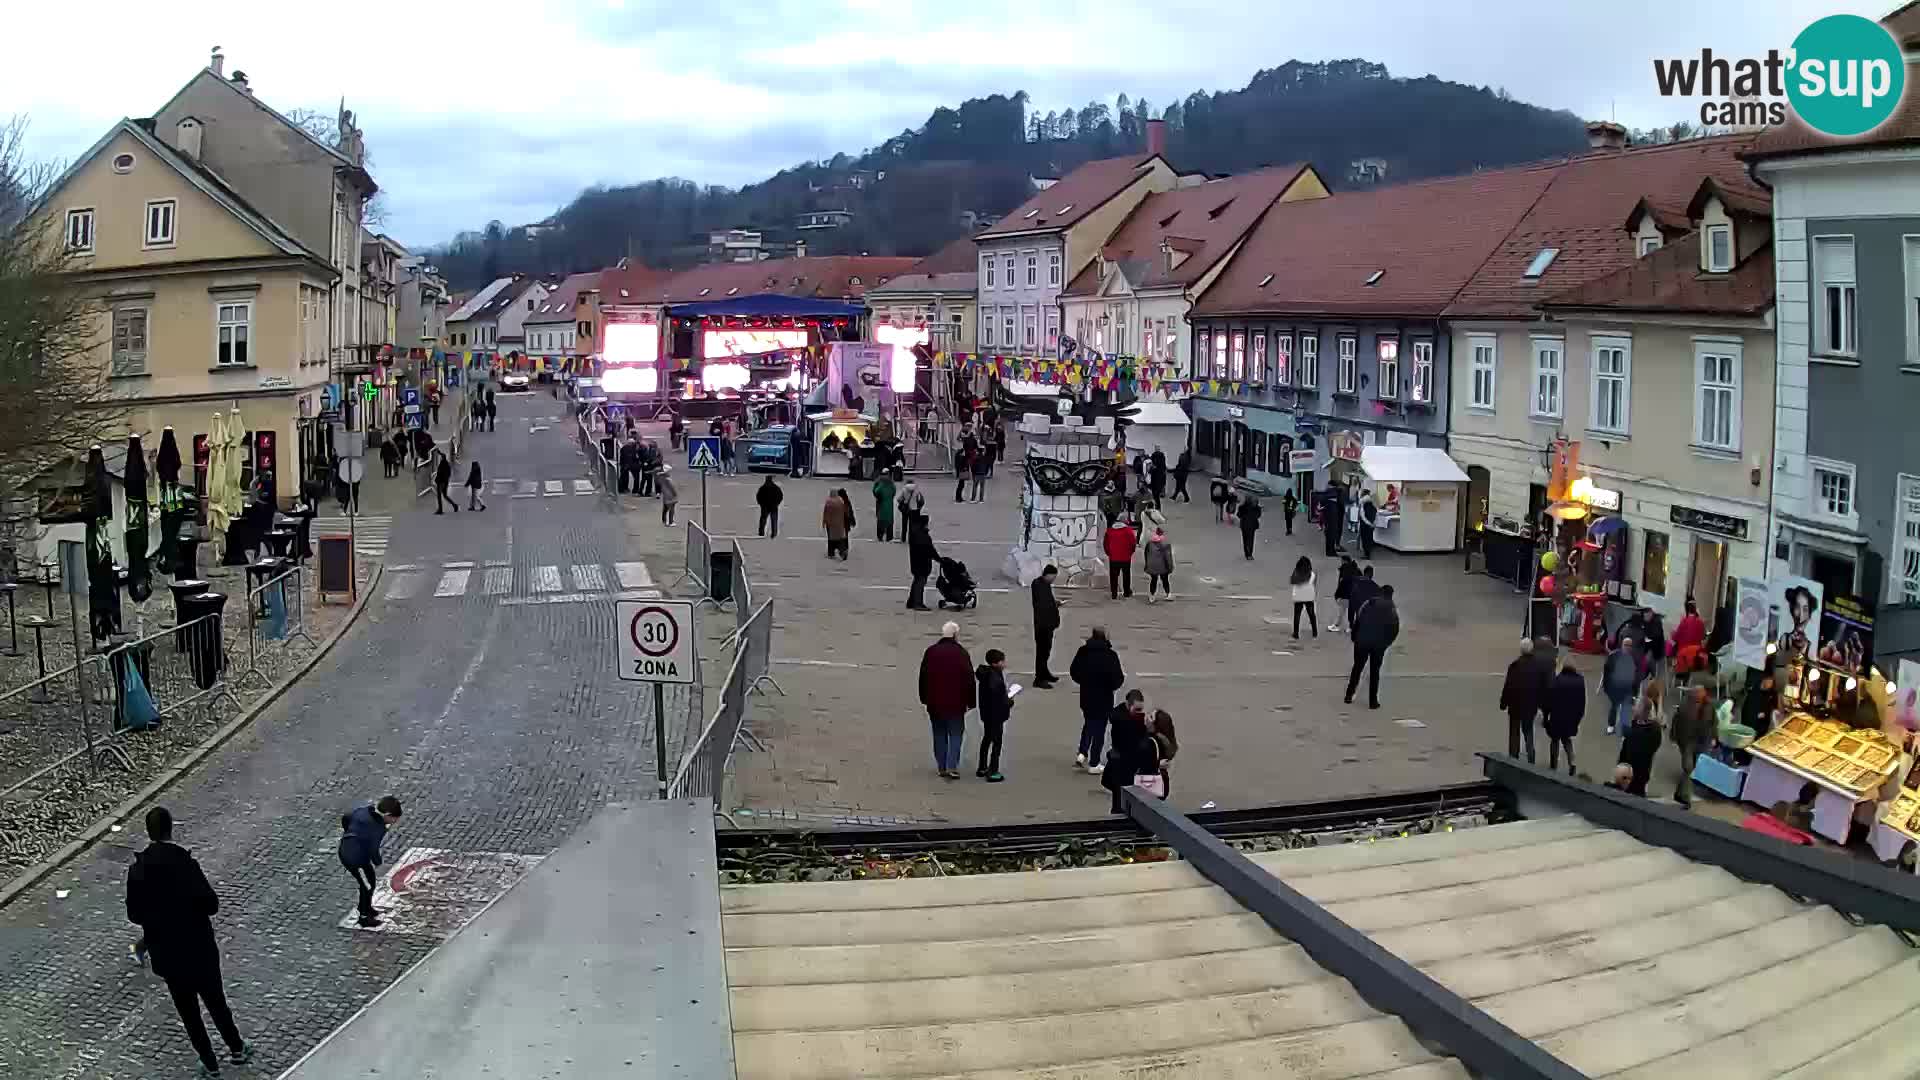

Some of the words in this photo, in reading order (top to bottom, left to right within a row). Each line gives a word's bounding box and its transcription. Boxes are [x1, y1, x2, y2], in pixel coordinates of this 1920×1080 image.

[407, 391, 416, 402] P
[643, 622, 667, 643] 30
[633, 659, 679, 676] ZONA
